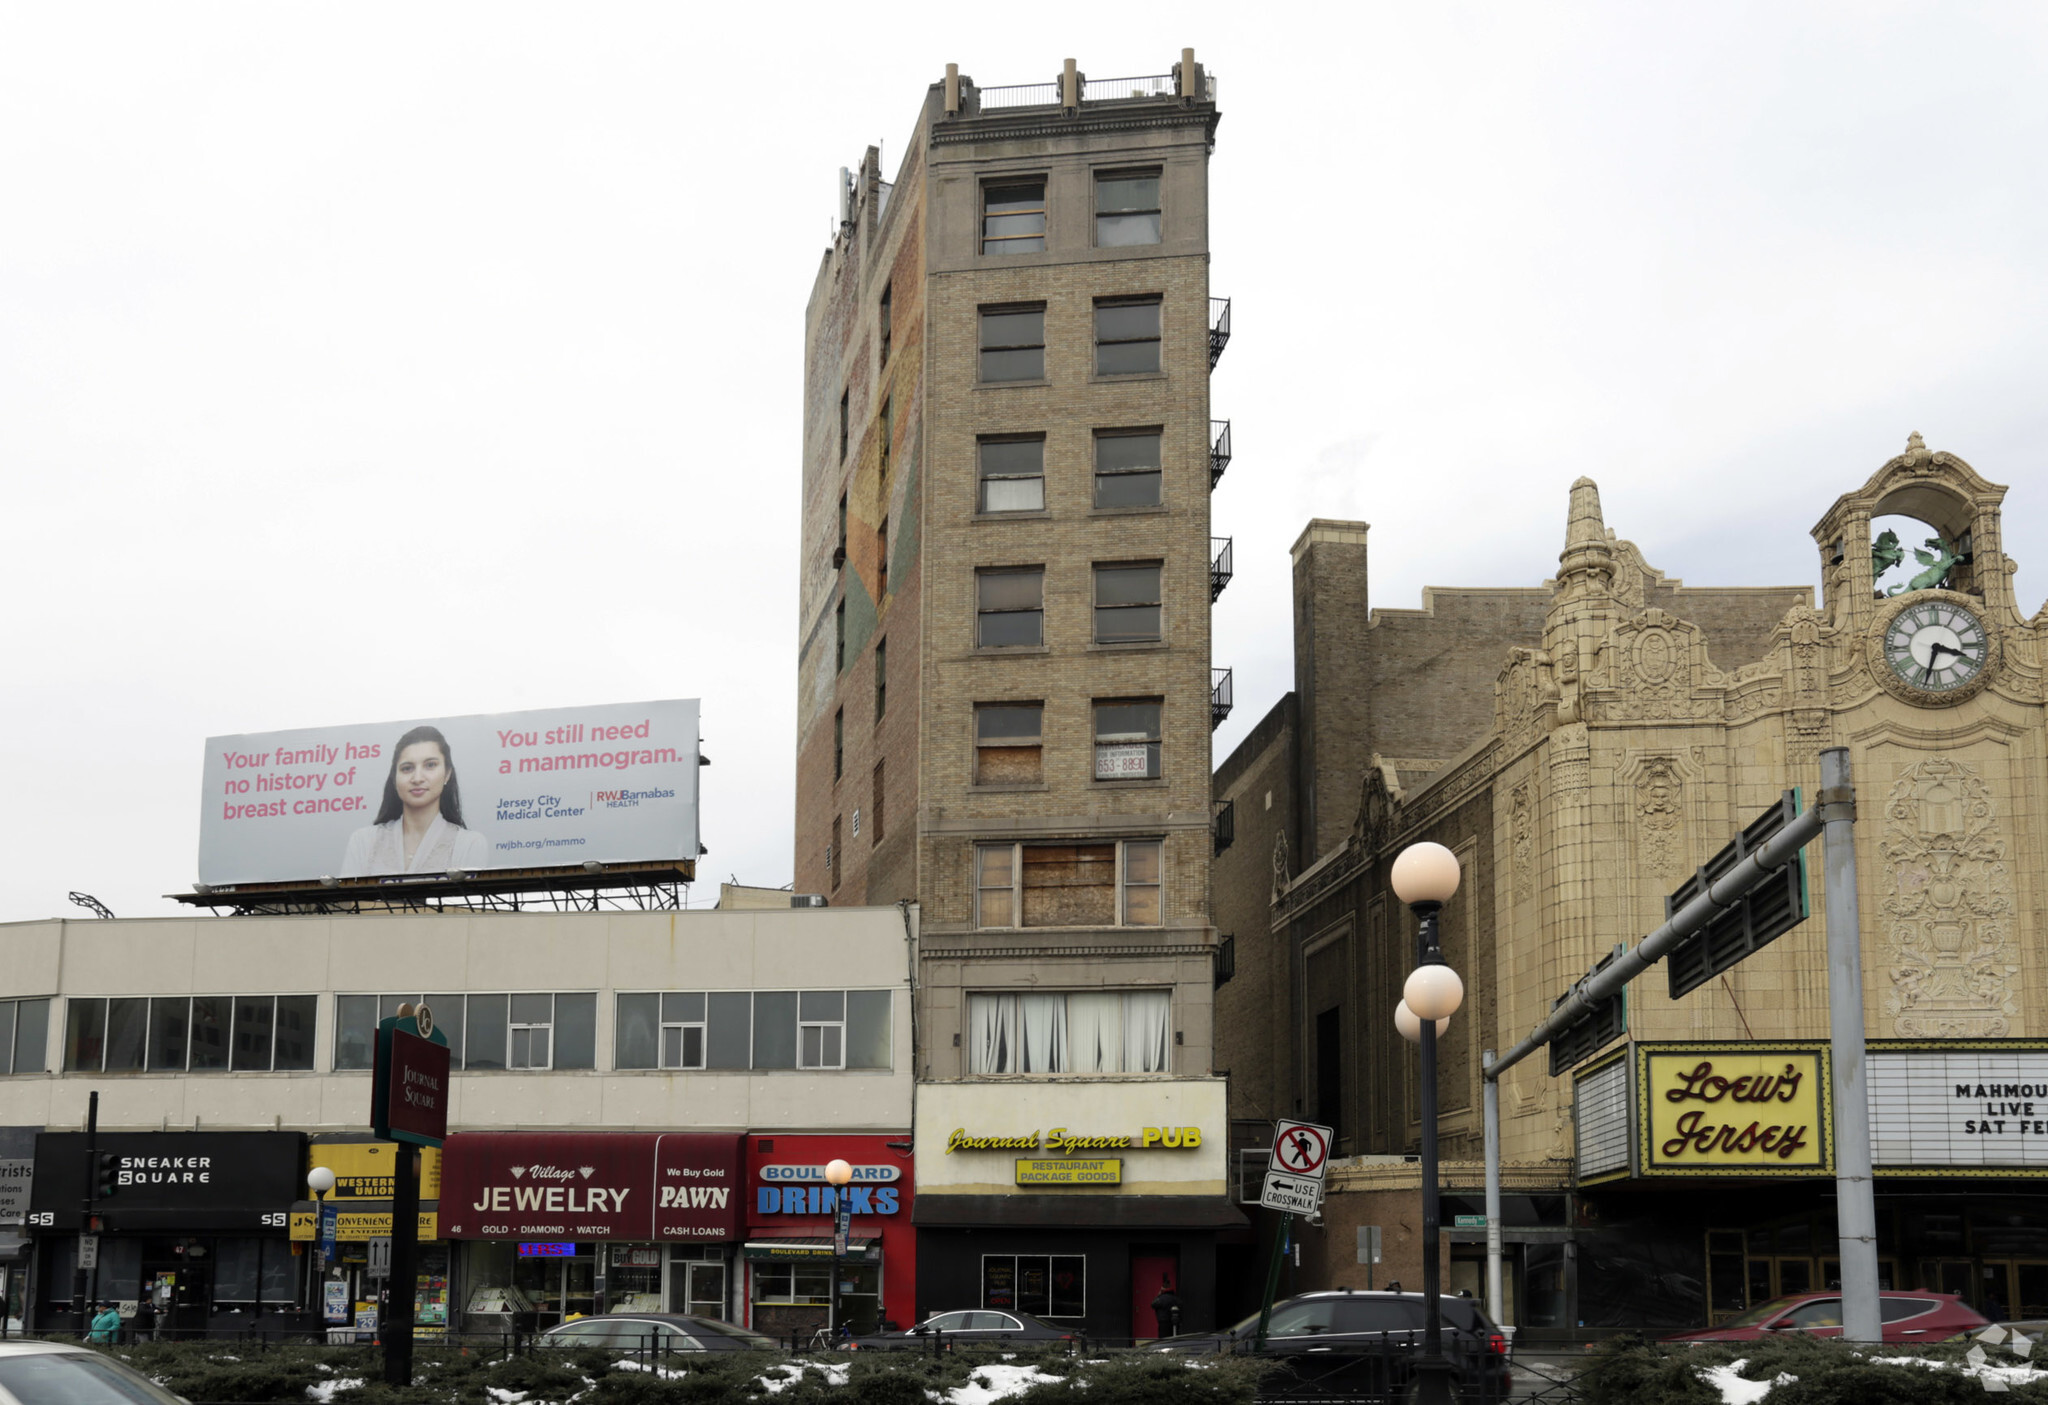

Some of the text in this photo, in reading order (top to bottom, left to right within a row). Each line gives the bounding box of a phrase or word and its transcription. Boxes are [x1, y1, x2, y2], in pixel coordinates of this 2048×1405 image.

[497, 719, 650, 748] You still need
[223, 742, 381, 769] Your family has
[498, 747, 683, 774] a mammogram.
[225, 766, 356, 795] no history of
[223, 795, 367, 820] breast cancer.
[497, 795, 561, 809] Jersey City
[606, 800, 639, 808] HEALTH
[496, 806, 585, 820] Medical Center
[496, 837, 586, 851] rwjbh.org/mammo
[402, 1065, 439, 1090] JOURNAL
[1666, 1061, 1803, 1103] Loew's
[404, 1086, 435, 1108] SQUARE
[1987, 1102, 2034, 1116] LIVE
[1965, 1120, 2048, 1134] SAT FE
[945, 1126, 1202, 1155] Journal Square PUB
[1662, 1111, 1807, 1159] Jersey
[0, 1163, 32, 1178] rists
[120, 1157, 211, 1169] SNEAKER
[1032, 1161, 1105, 1171] RESTAURANT
[118, 1170, 210, 1185] SQUARE
[529, 1164, 575, 1183] Village
[667, 1168, 725, 1178] We Buy Gold
[766, 1167, 893, 1180] BOULARD
[1020, 1172, 1117, 1182] PACKAGE GOODS
[0, 1184, 22, 1194] tions
[355, 1186, 394, 1195] UNION
[1295, 1184, 1315, 1197] USE
[473, 1187, 630, 1213] JEWELRY
[659, 1186, 730, 1209] PAWN
[757, 1187, 899, 1214] DRINKS
[1266, 1191, 1313, 1209] CROSSWALK
[337, 1216, 392, 1226] ONVENIENC
[482, 1225, 610, 1234] GOLD DIAMOND WATCH
[663, 1226, 726, 1236] CASH LOANS
[614, 1250, 658, 1265] BUY GOLD
